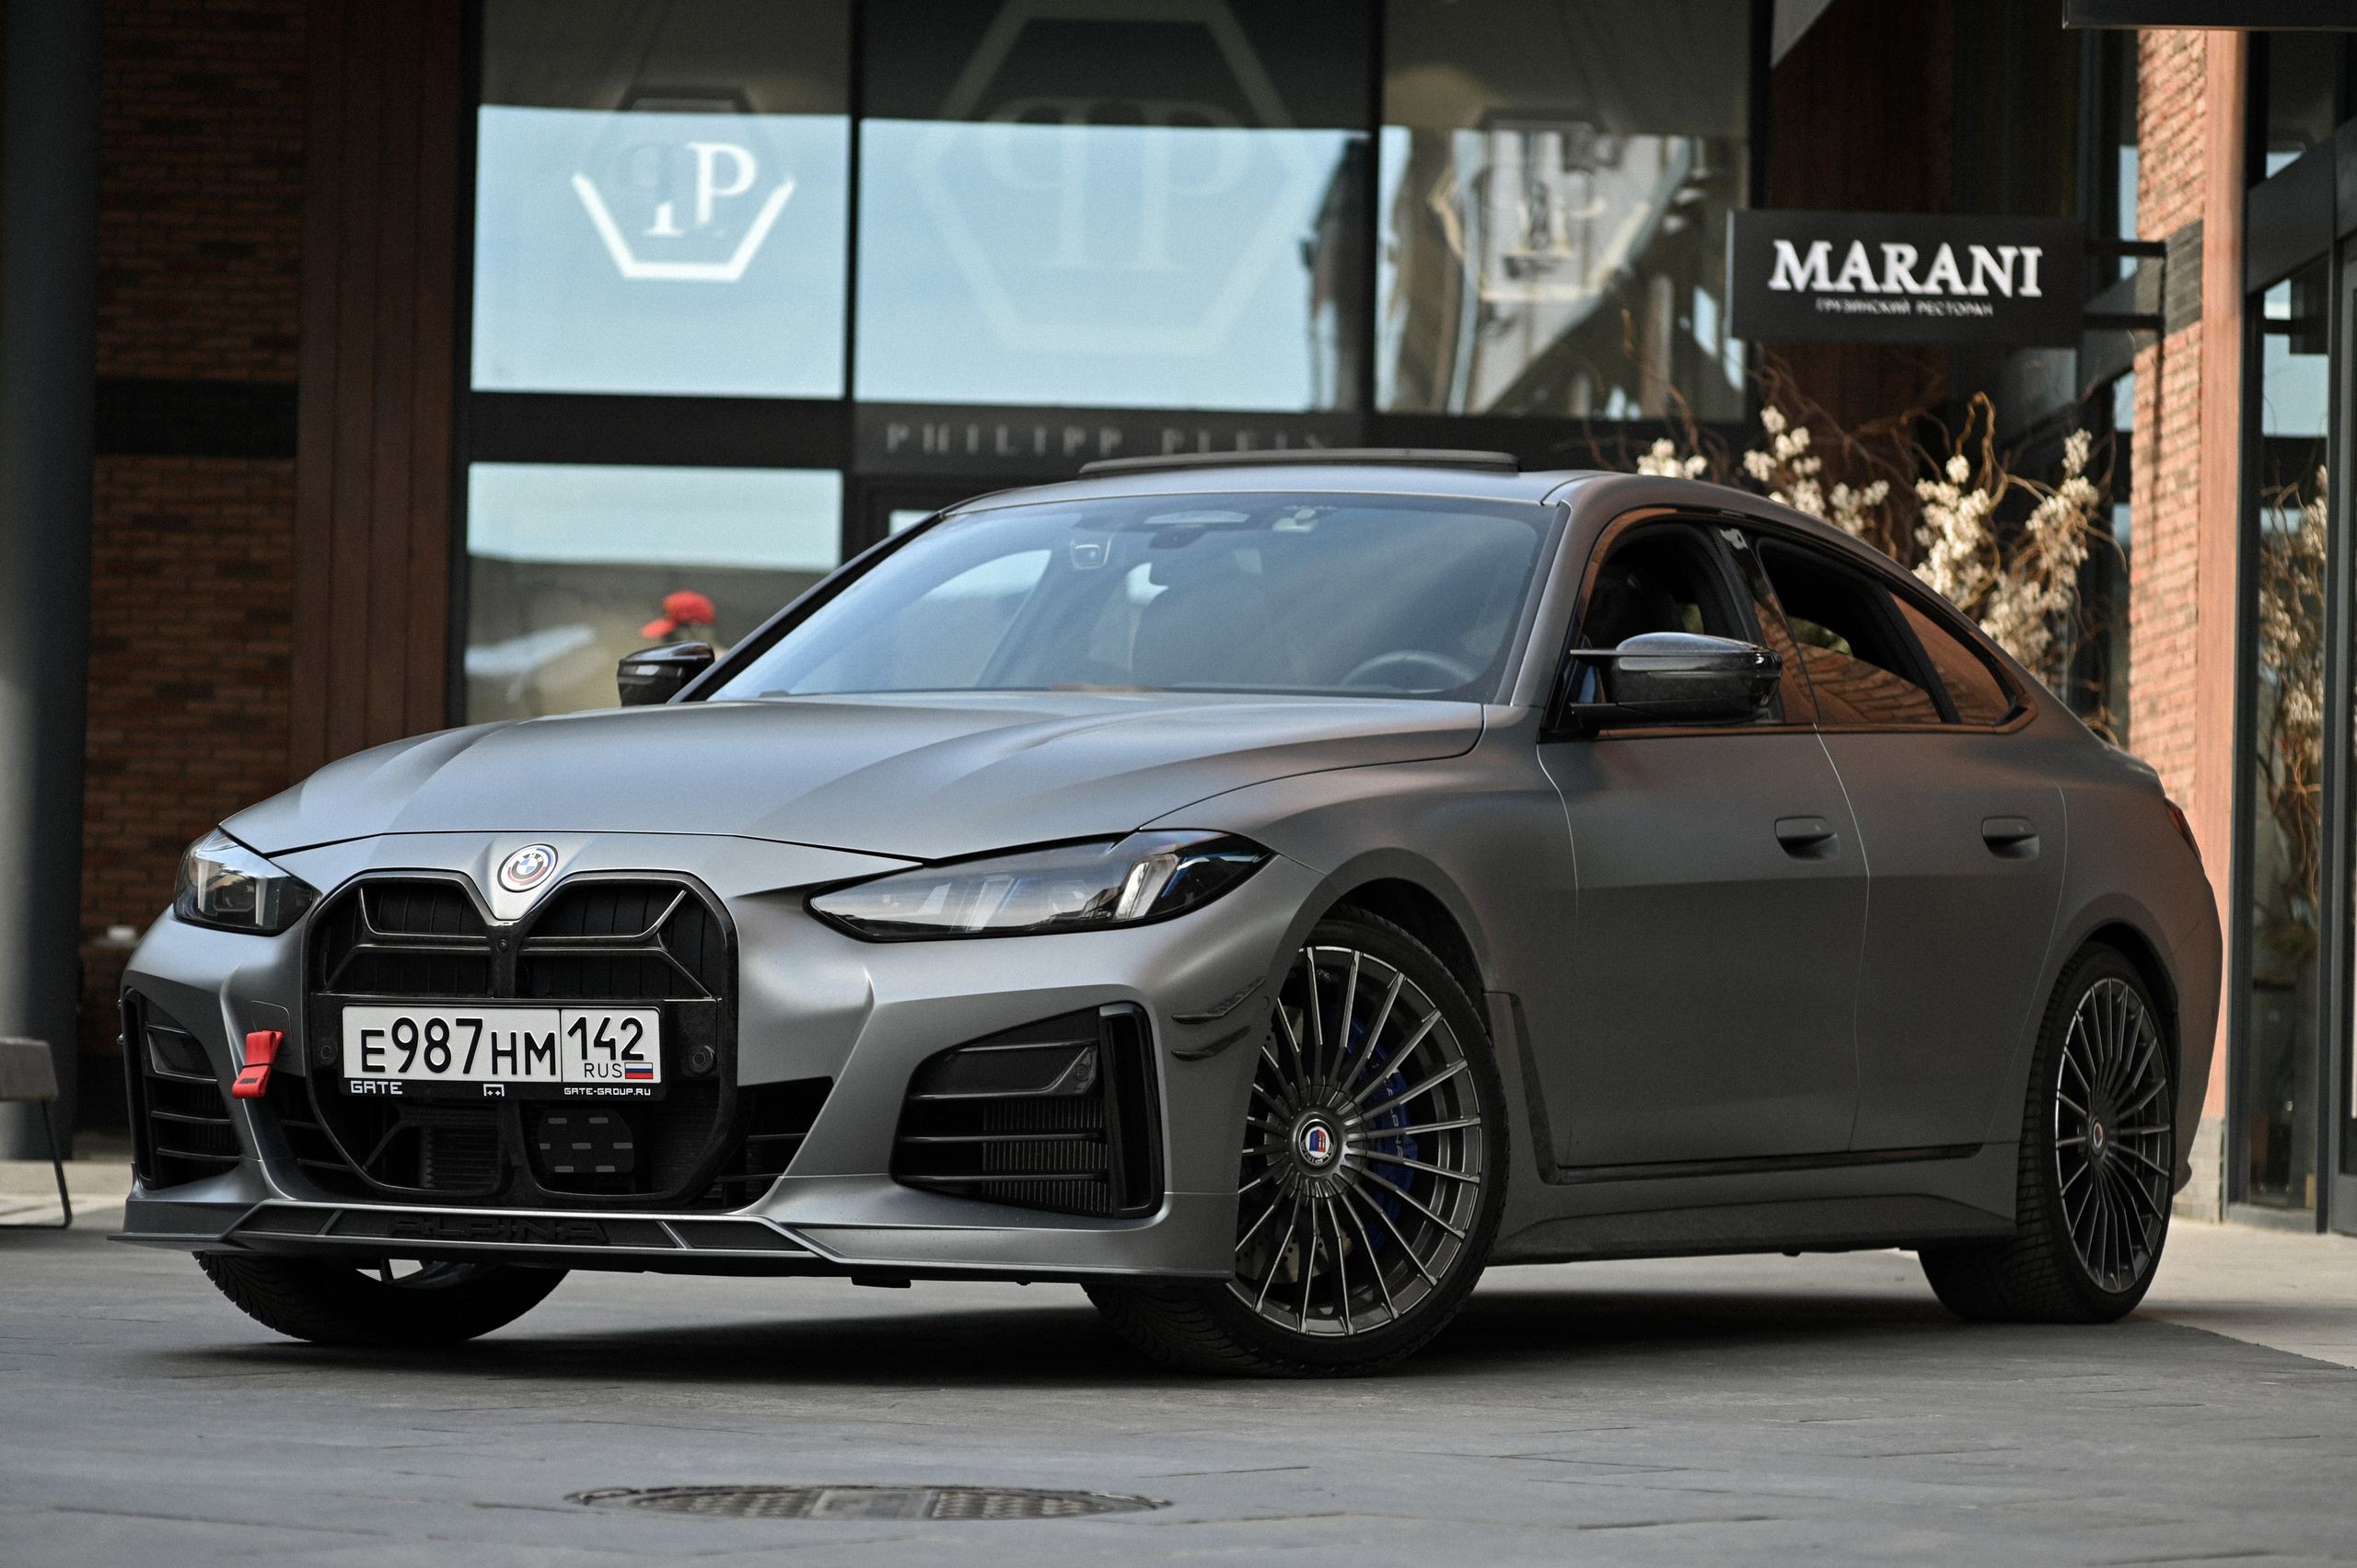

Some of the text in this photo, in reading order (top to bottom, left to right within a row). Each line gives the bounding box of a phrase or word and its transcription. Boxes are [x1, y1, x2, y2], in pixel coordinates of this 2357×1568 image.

[1768, 238, 2043, 297] MARANI
[1916, 301, 1993, 317] РЕСТОРАН
[887, 422, 1123, 457] PHILIPP
[361, 1016, 644, 1076] E987HM 142
[584, 1063, 623, 1078] RUS
[351, 1080, 403, 1095] GATE
[563, 1086, 651, 1097] GATE-GROUP.RU
[391, 1216, 607, 1242] ALPINA
